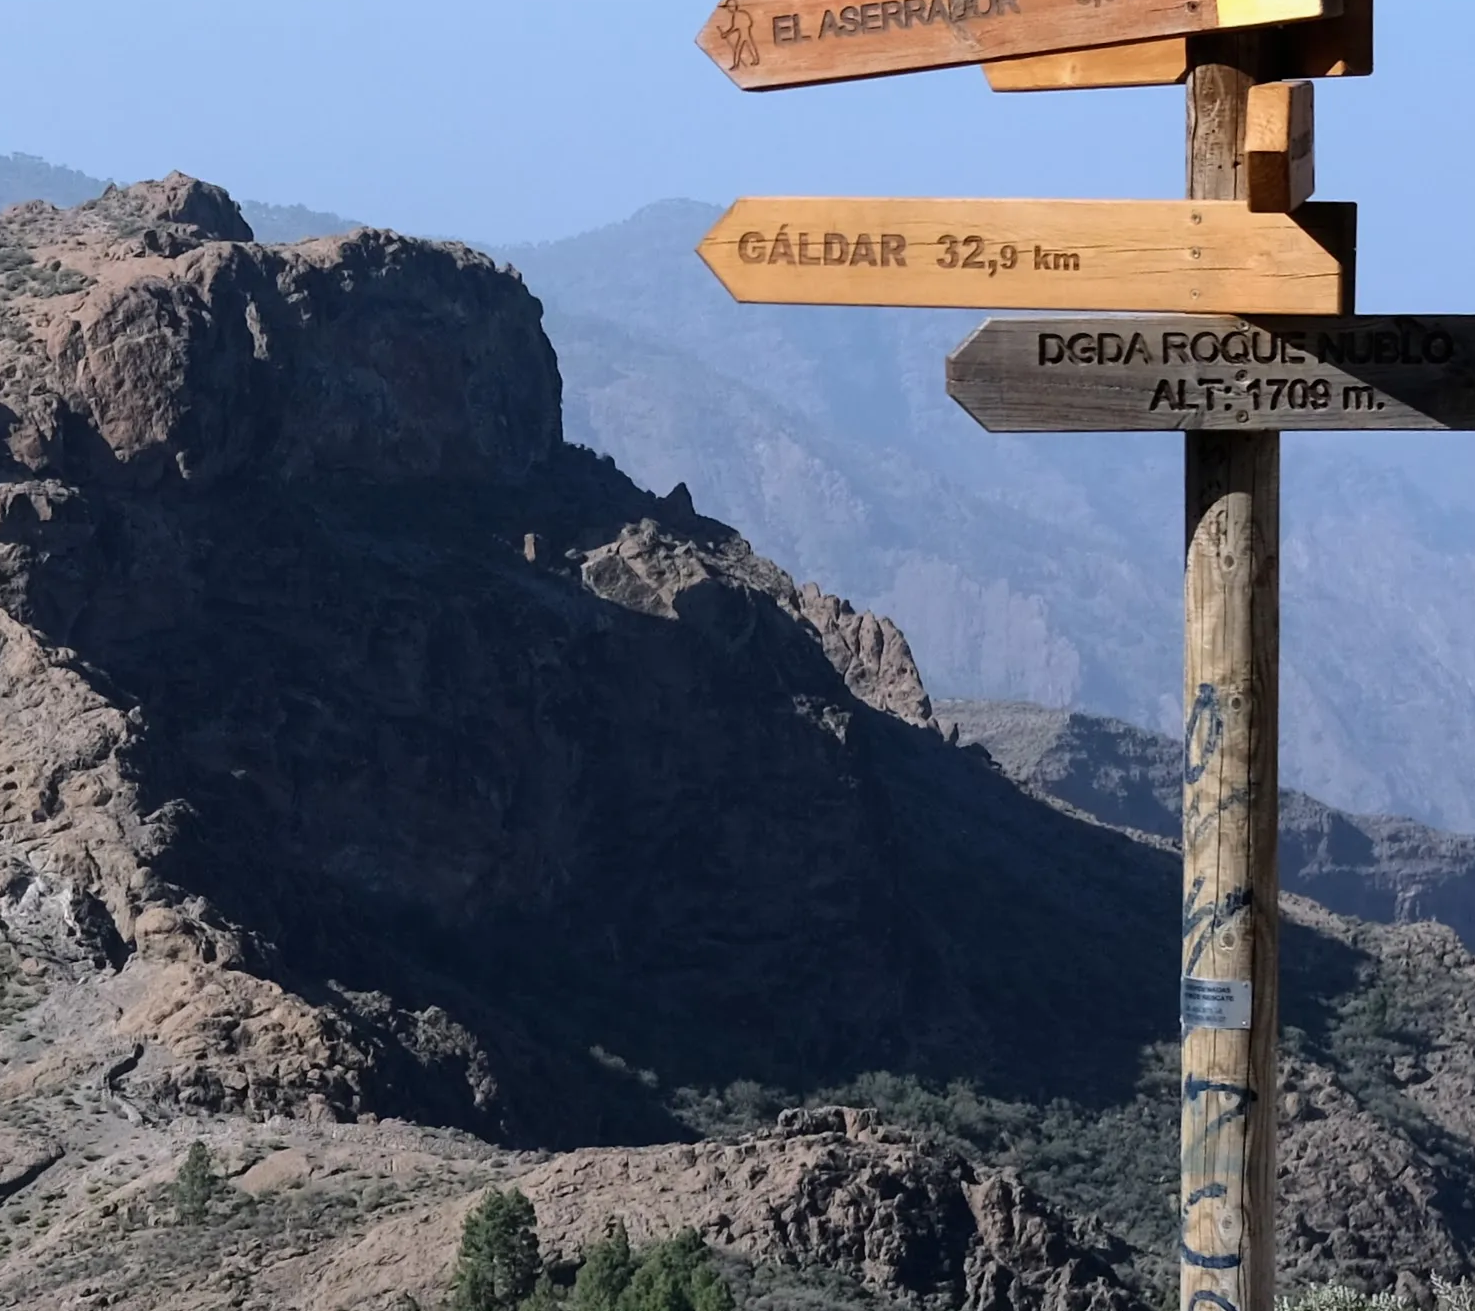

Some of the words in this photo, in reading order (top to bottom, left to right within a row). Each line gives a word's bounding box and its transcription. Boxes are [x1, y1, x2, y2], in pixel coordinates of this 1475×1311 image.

[772, 14, 811, 45] EL
[737, 223, 908, 268] GÁLDAR
[936, 234, 1019, 278] 32,9
[1033, 245, 1081, 272] km
[1161, 331, 1306, 366] ROQUE
[1318, 331, 1454, 365] NUBLO
[1149, 378, 1233, 411] ALT:
[1246, 378, 1332, 411] 1709
[1342, 382, 1385, 411] m.
